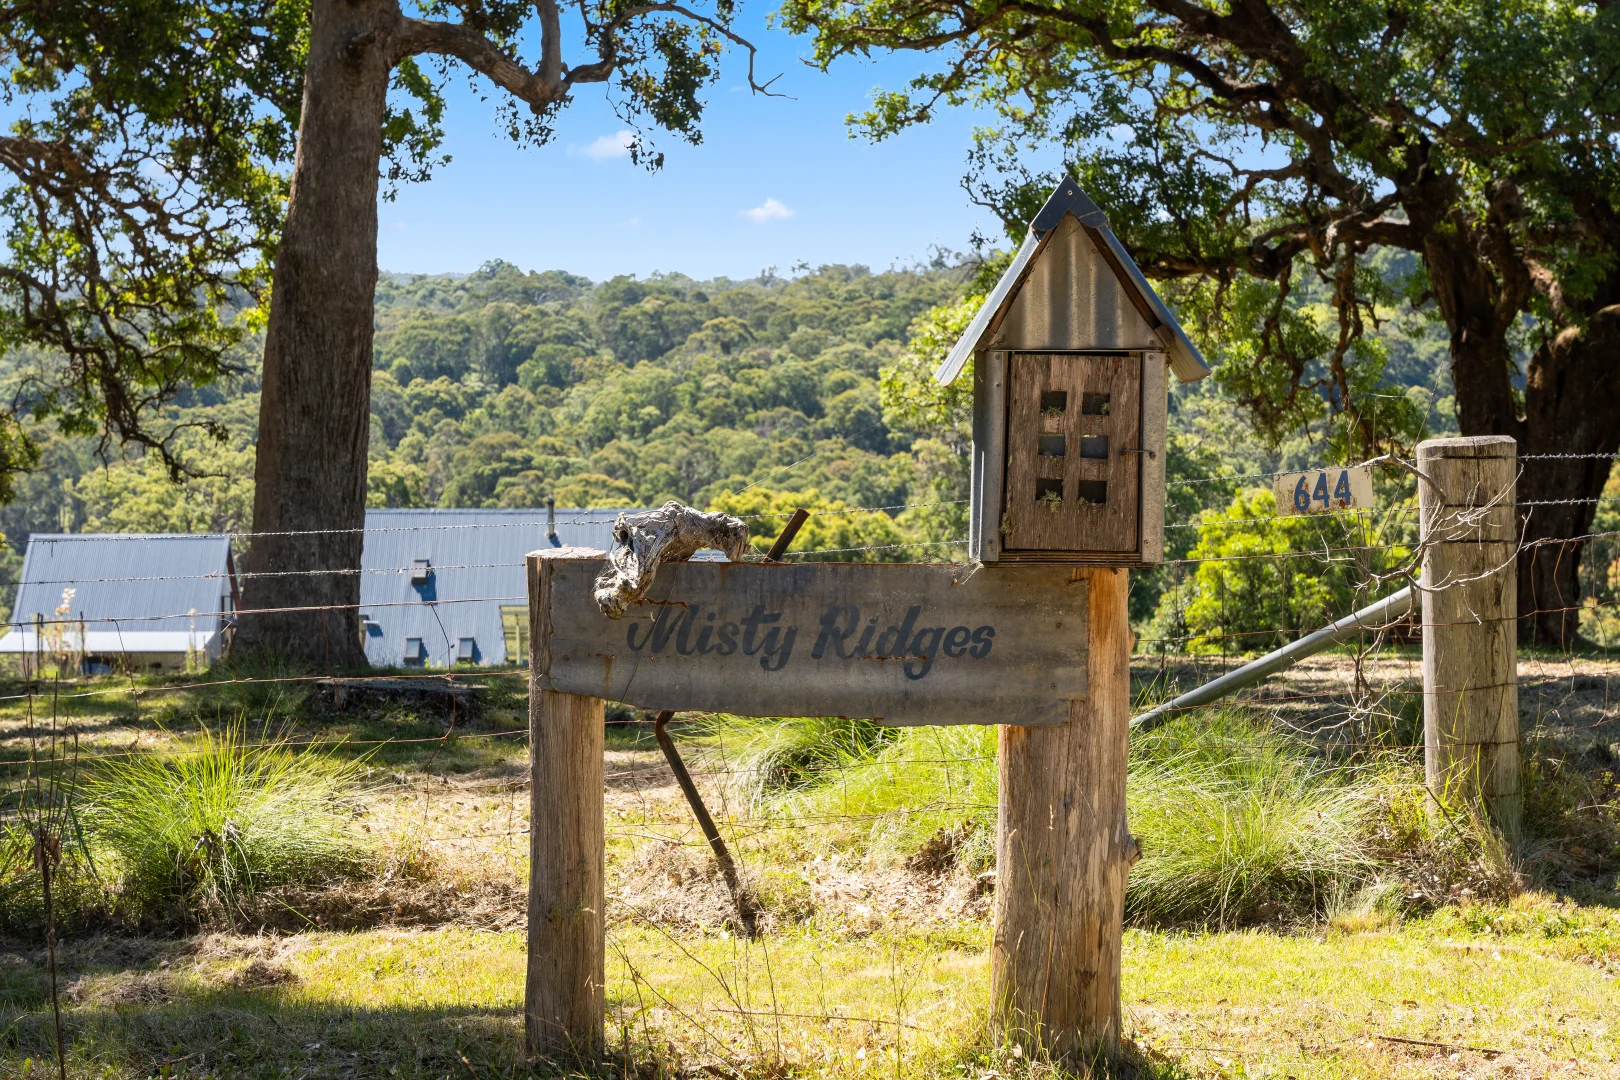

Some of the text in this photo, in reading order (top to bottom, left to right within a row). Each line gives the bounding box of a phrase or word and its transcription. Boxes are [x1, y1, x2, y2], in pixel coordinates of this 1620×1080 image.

[1293, 470, 1352, 511] 644
[627, 603, 996, 680] Misty Ridges
